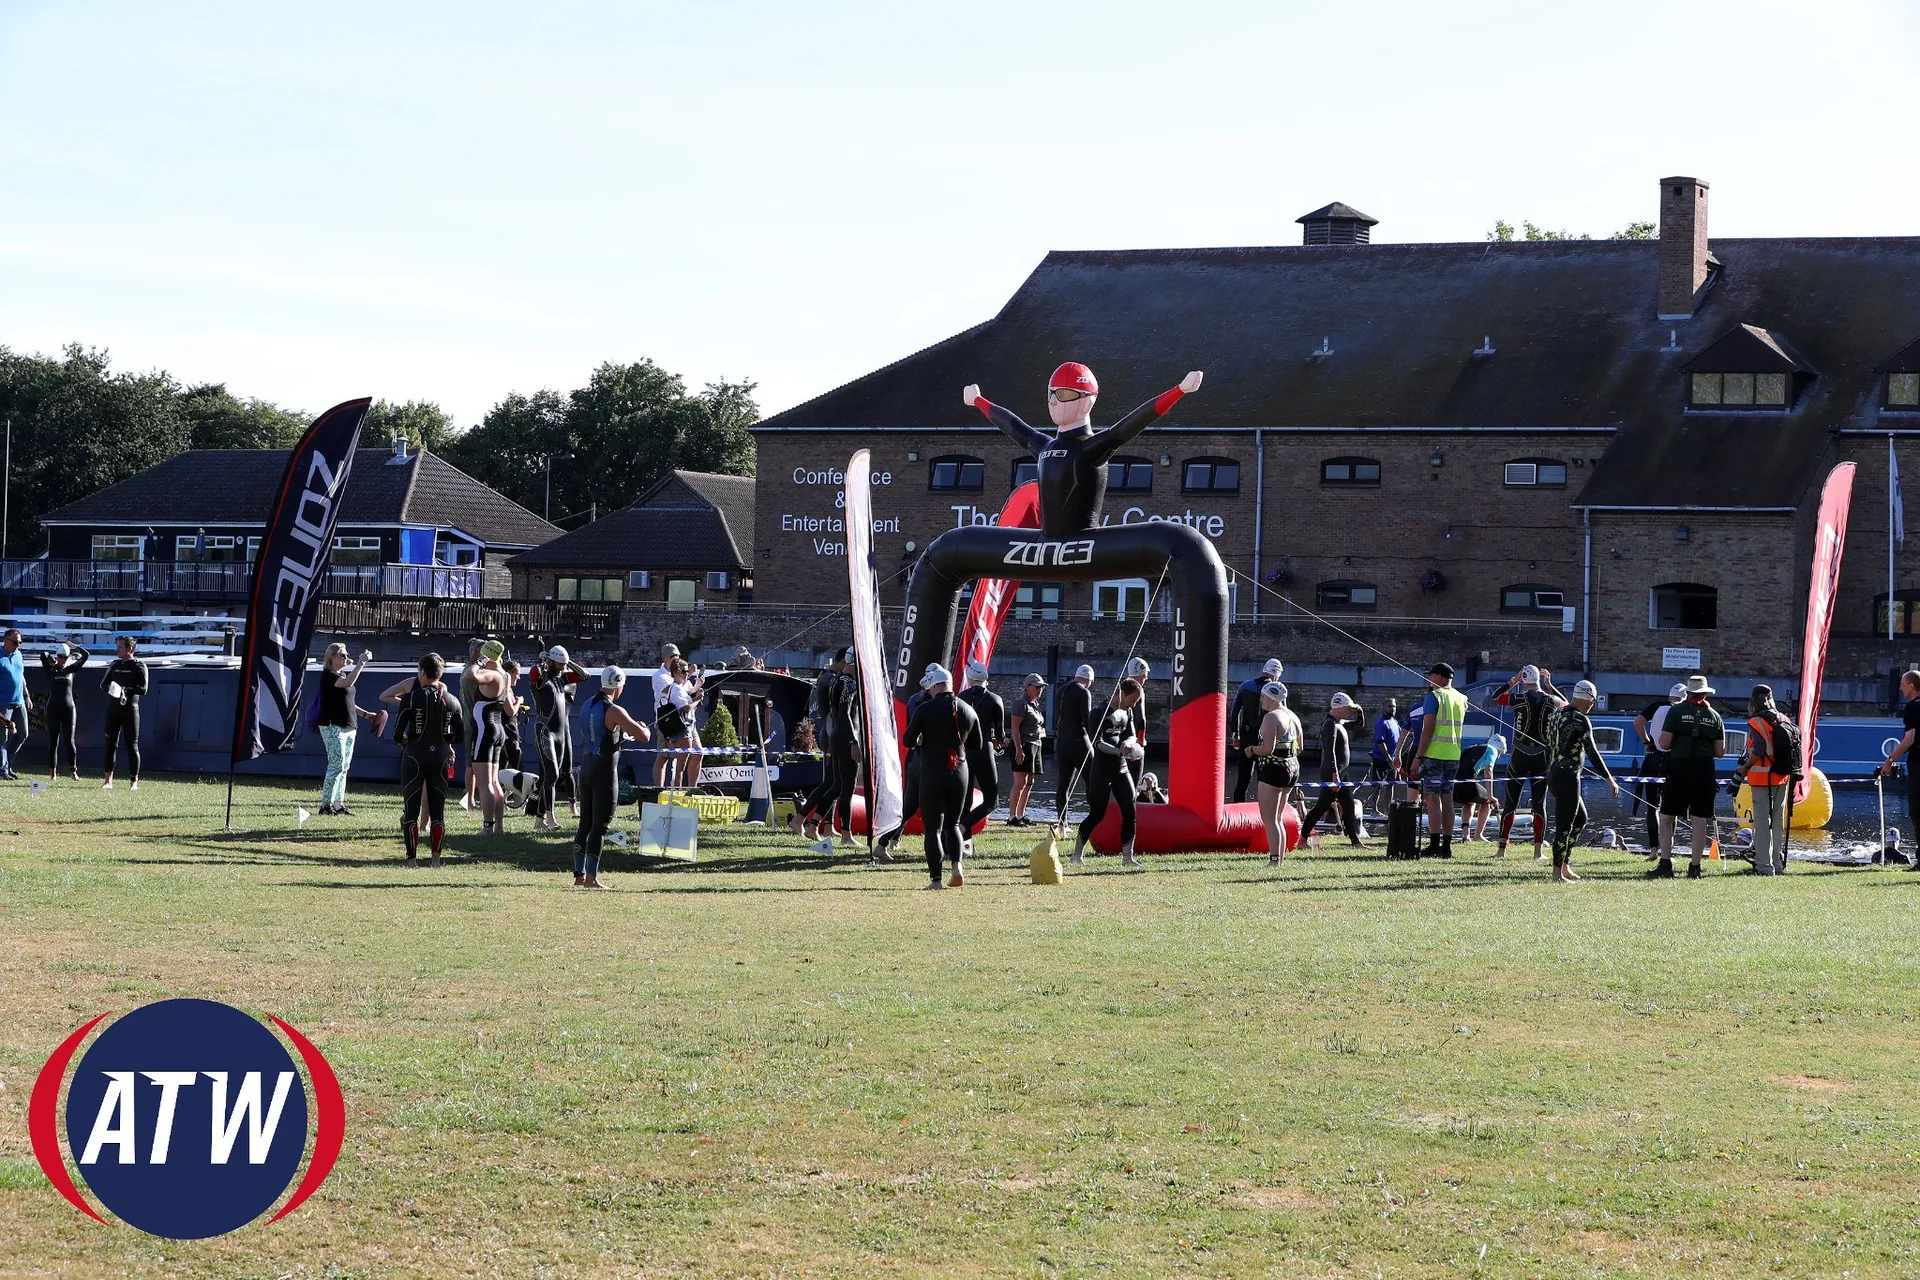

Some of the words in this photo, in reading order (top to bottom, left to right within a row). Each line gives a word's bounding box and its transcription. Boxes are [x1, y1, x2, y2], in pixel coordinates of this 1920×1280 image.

[793, 467, 892, 485] Confece
[813, 538, 847, 556] Ven
[1003, 539, 1095, 567] ZONE3
[896, 605, 918, 687] GOOD
[1173, 607, 1186, 696] LUCK
[415, 708, 423, 734] HUUB
[700, 768, 724, 781] New
[725, 767, 773, 780] Vente
